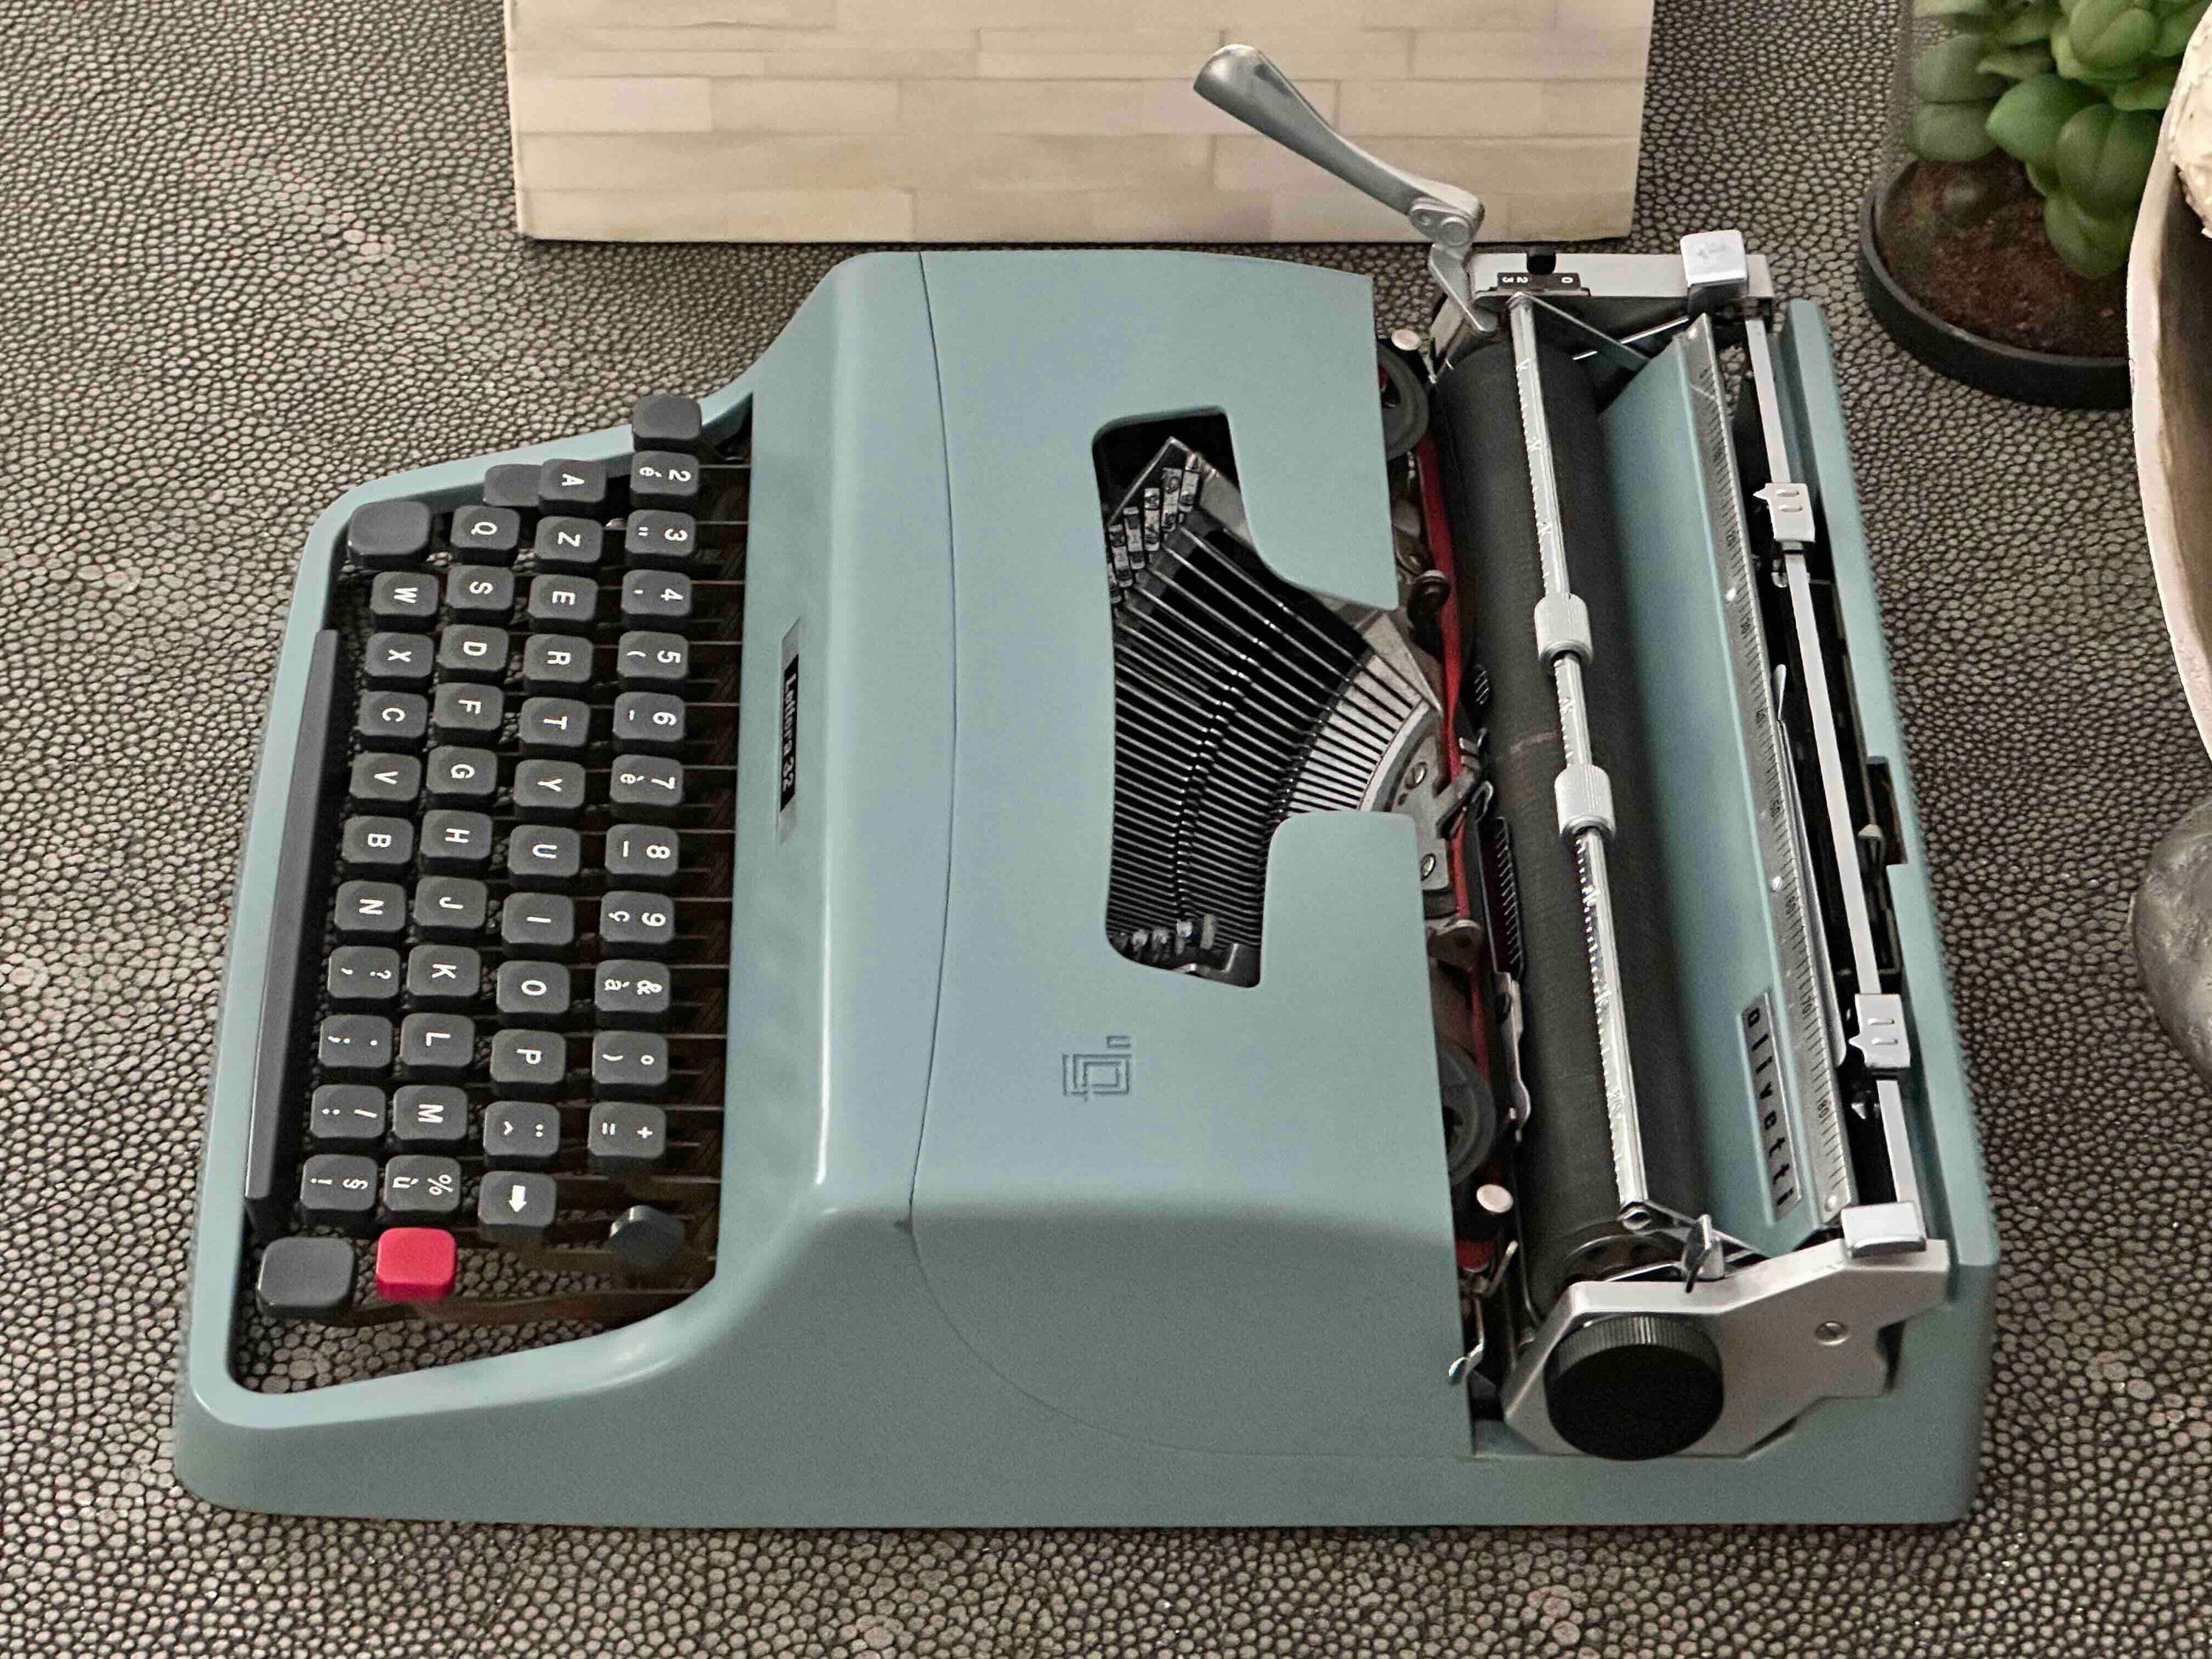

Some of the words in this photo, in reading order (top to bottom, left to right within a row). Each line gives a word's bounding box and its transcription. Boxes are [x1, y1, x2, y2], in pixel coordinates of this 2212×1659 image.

[639, 466, 662, 478] é
[668, 469, 692, 482] 2
[561, 473, 585, 487] A
[470, 521, 498, 535] Q
[664, 528, 688, 541] 3
[557, 532, 581, 547] Z
[469, 581, 493, 595] S
[660, 588, 684, 602] 4
[393, 587, 418, 604] W
[552, 591, 576, 605] E
[463, 641, 487, 656] D
[387, 649, 412, 663] X
[547, 650, 571, 665] R
[657, 650, 681, 664] 5
[458, 699, 481, 714] F
[382, 707, 406, 723] C
[653, 712, 677, 726] 6
[783, 672, 797, 757] Lettera
[543, 716, 568, 731] T
[374, 771, 398, 785] V
[451, 764, 476, 779] G
[782, 756, 795, 792] 32
[537, 778, 563, 792] Y
[619, 773, 644, 785] è
[650, 776, 675, 790] 7
[367, 833, 392, 848] B
[445, 828, 470, 844] H
[532, 844, 557, 859] U
[646, 844, 671, 859] 8
[358, 898, 384, 915] N
[439, 897, 464, 910] J
[608, 911, 630, 922] ç
[641, 912, 666, 927] 9
[369, 970, 392, 980] ?
[431, 964, 457, 979] K
[521, 979, 547, 996] O
[604, 978, 630, 991] à
[636, 979, 663, 995] &
[425, 1032, 451, 1047] L
[516, 1048, 542, 1065] P
[354, 1109, 378, 1119] /
[417, 1104, 444, 1124] M
[1747, 1007, 1795, 1207] olivetti
[602, 1122, 616, 1135] =
[636, 1126, 653, 1139] +
[342, 1178, 369, 1190] §
[392, 1176, 420, 1189] ù
[427, 1174, 453, 1196] %
